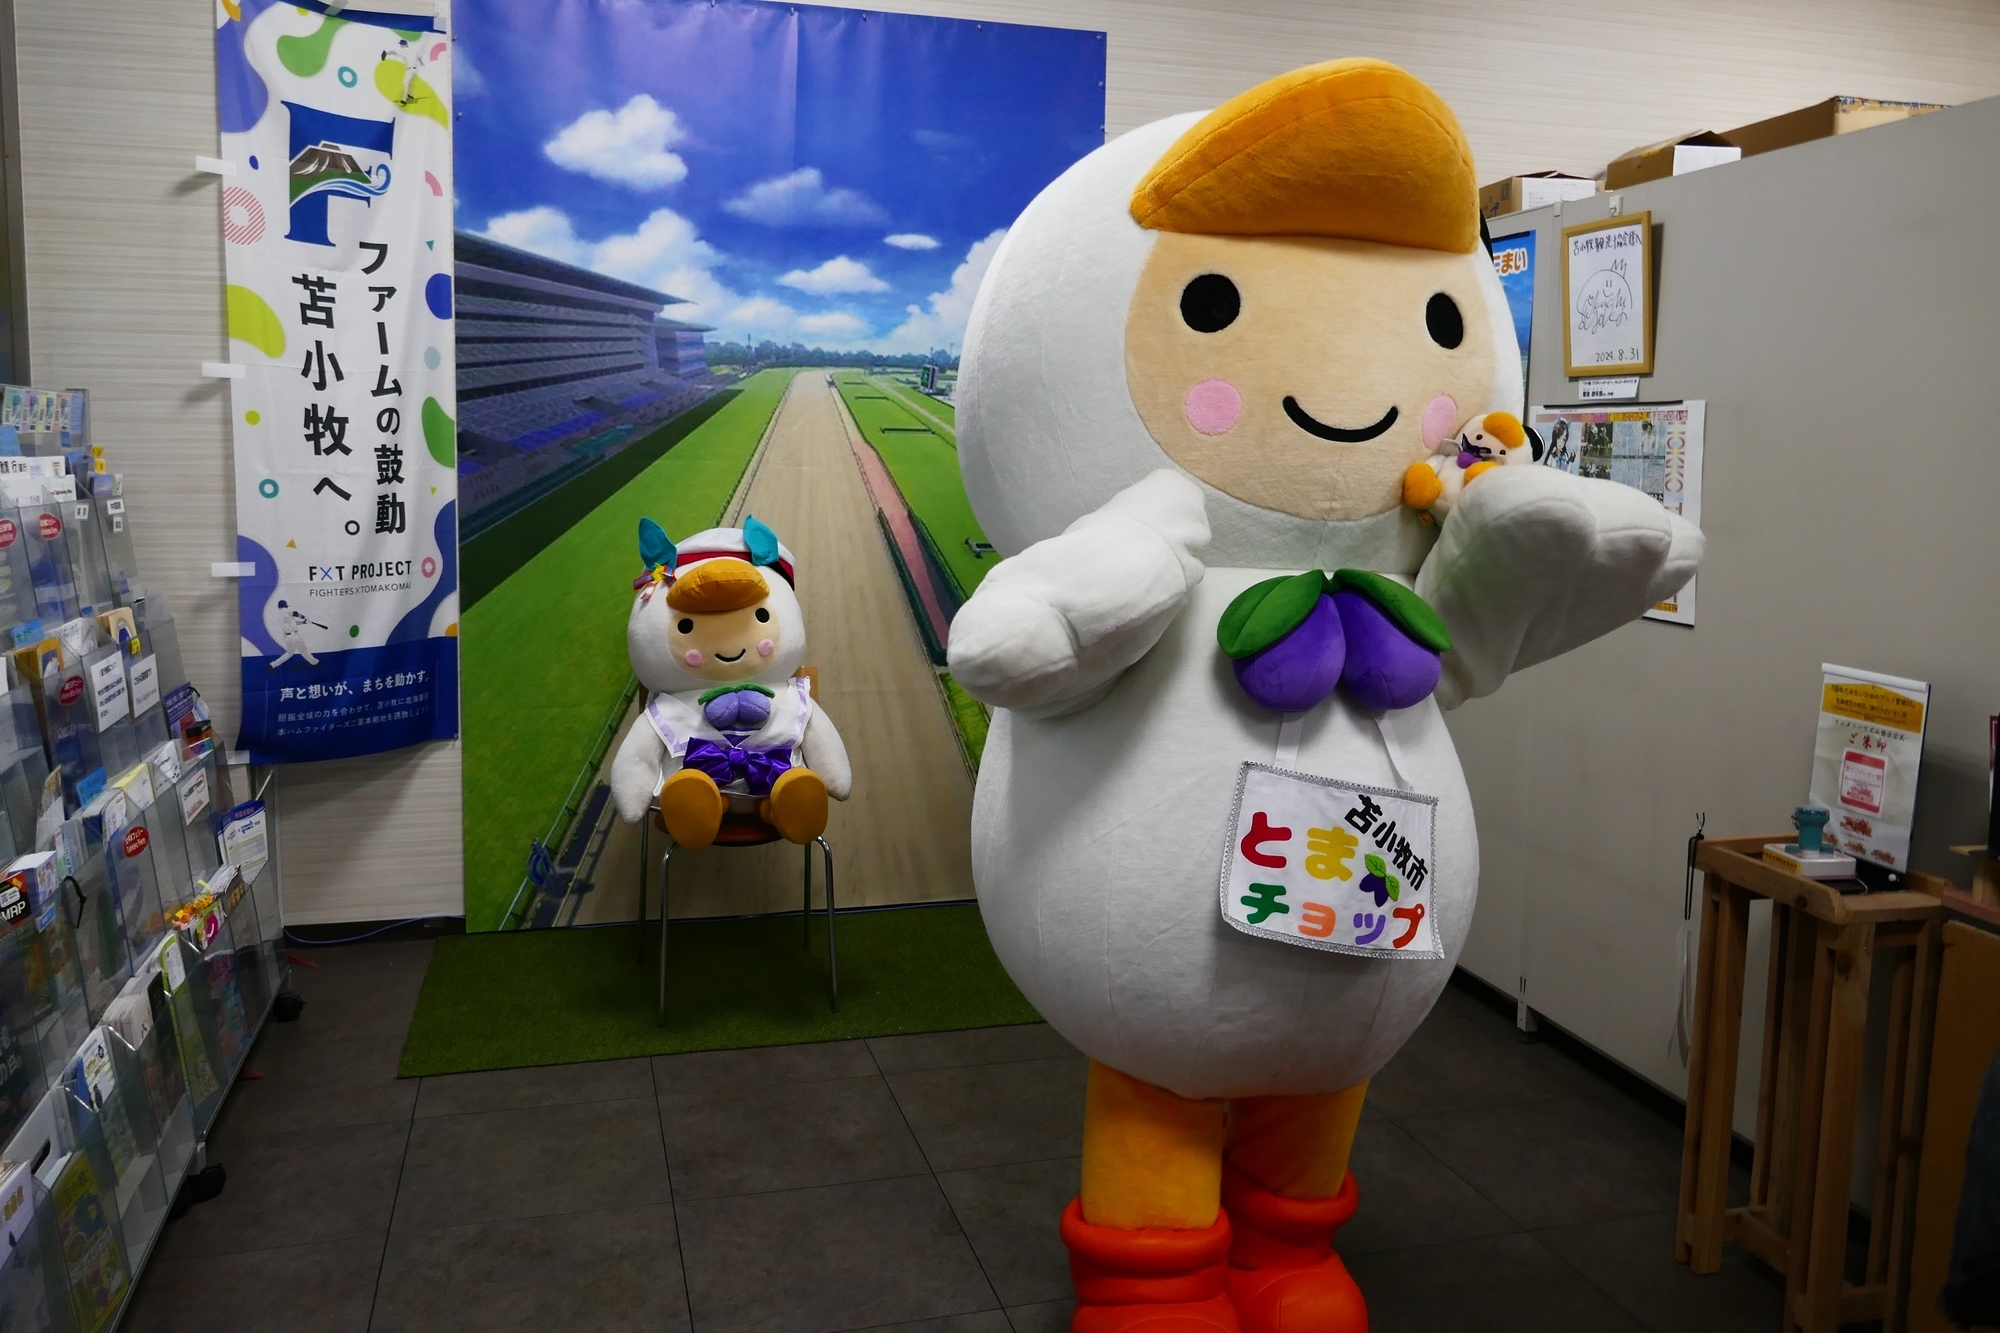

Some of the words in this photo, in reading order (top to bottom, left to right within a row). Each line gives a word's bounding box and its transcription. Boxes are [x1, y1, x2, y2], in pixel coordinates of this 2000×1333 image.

[292, 273, 360, 536] 苫小牧へ。
[359, 241, 406, 534] ファームの鼓動
[352, 560, 412, 580] PROJECT
[1344, 794, 1429, 891] 苫小牧市
